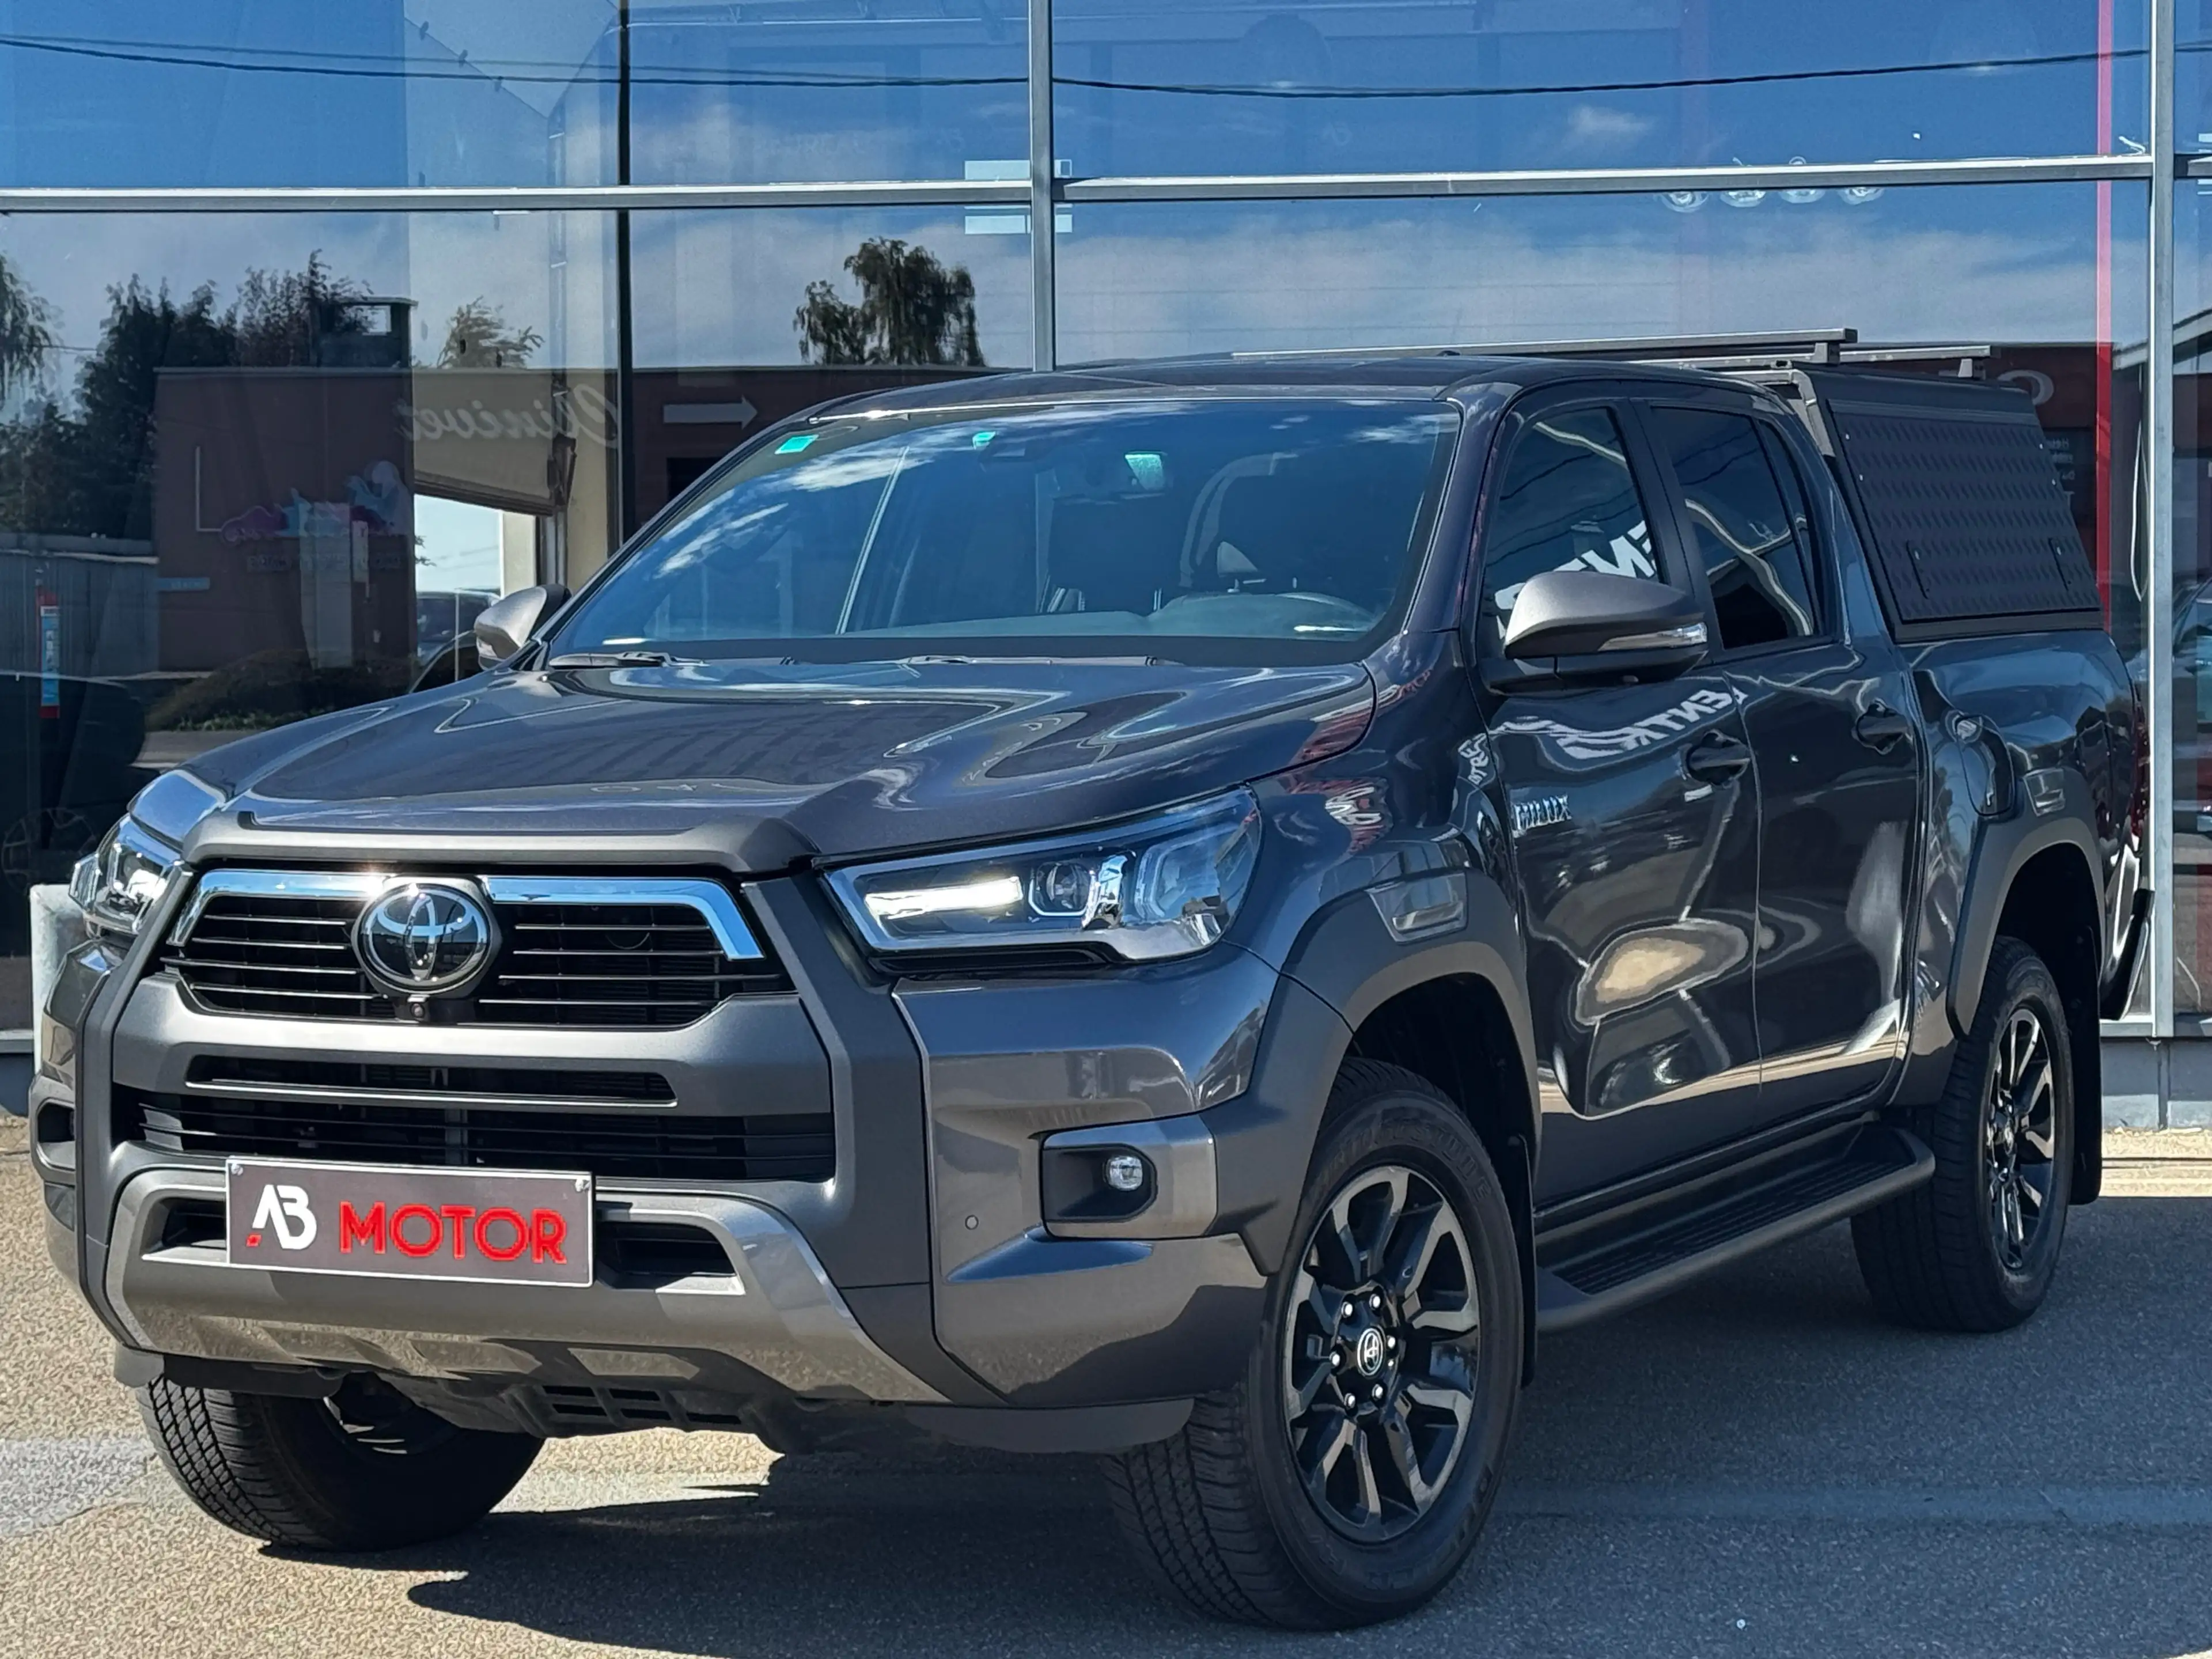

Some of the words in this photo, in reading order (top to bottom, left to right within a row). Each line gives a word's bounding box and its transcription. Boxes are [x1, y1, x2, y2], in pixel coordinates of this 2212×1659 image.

[1513, 793, 1573, 830] HILUX
[251, 1184, 317, 1251] AB
[339, 1200, 567, 1264] MOTOR
